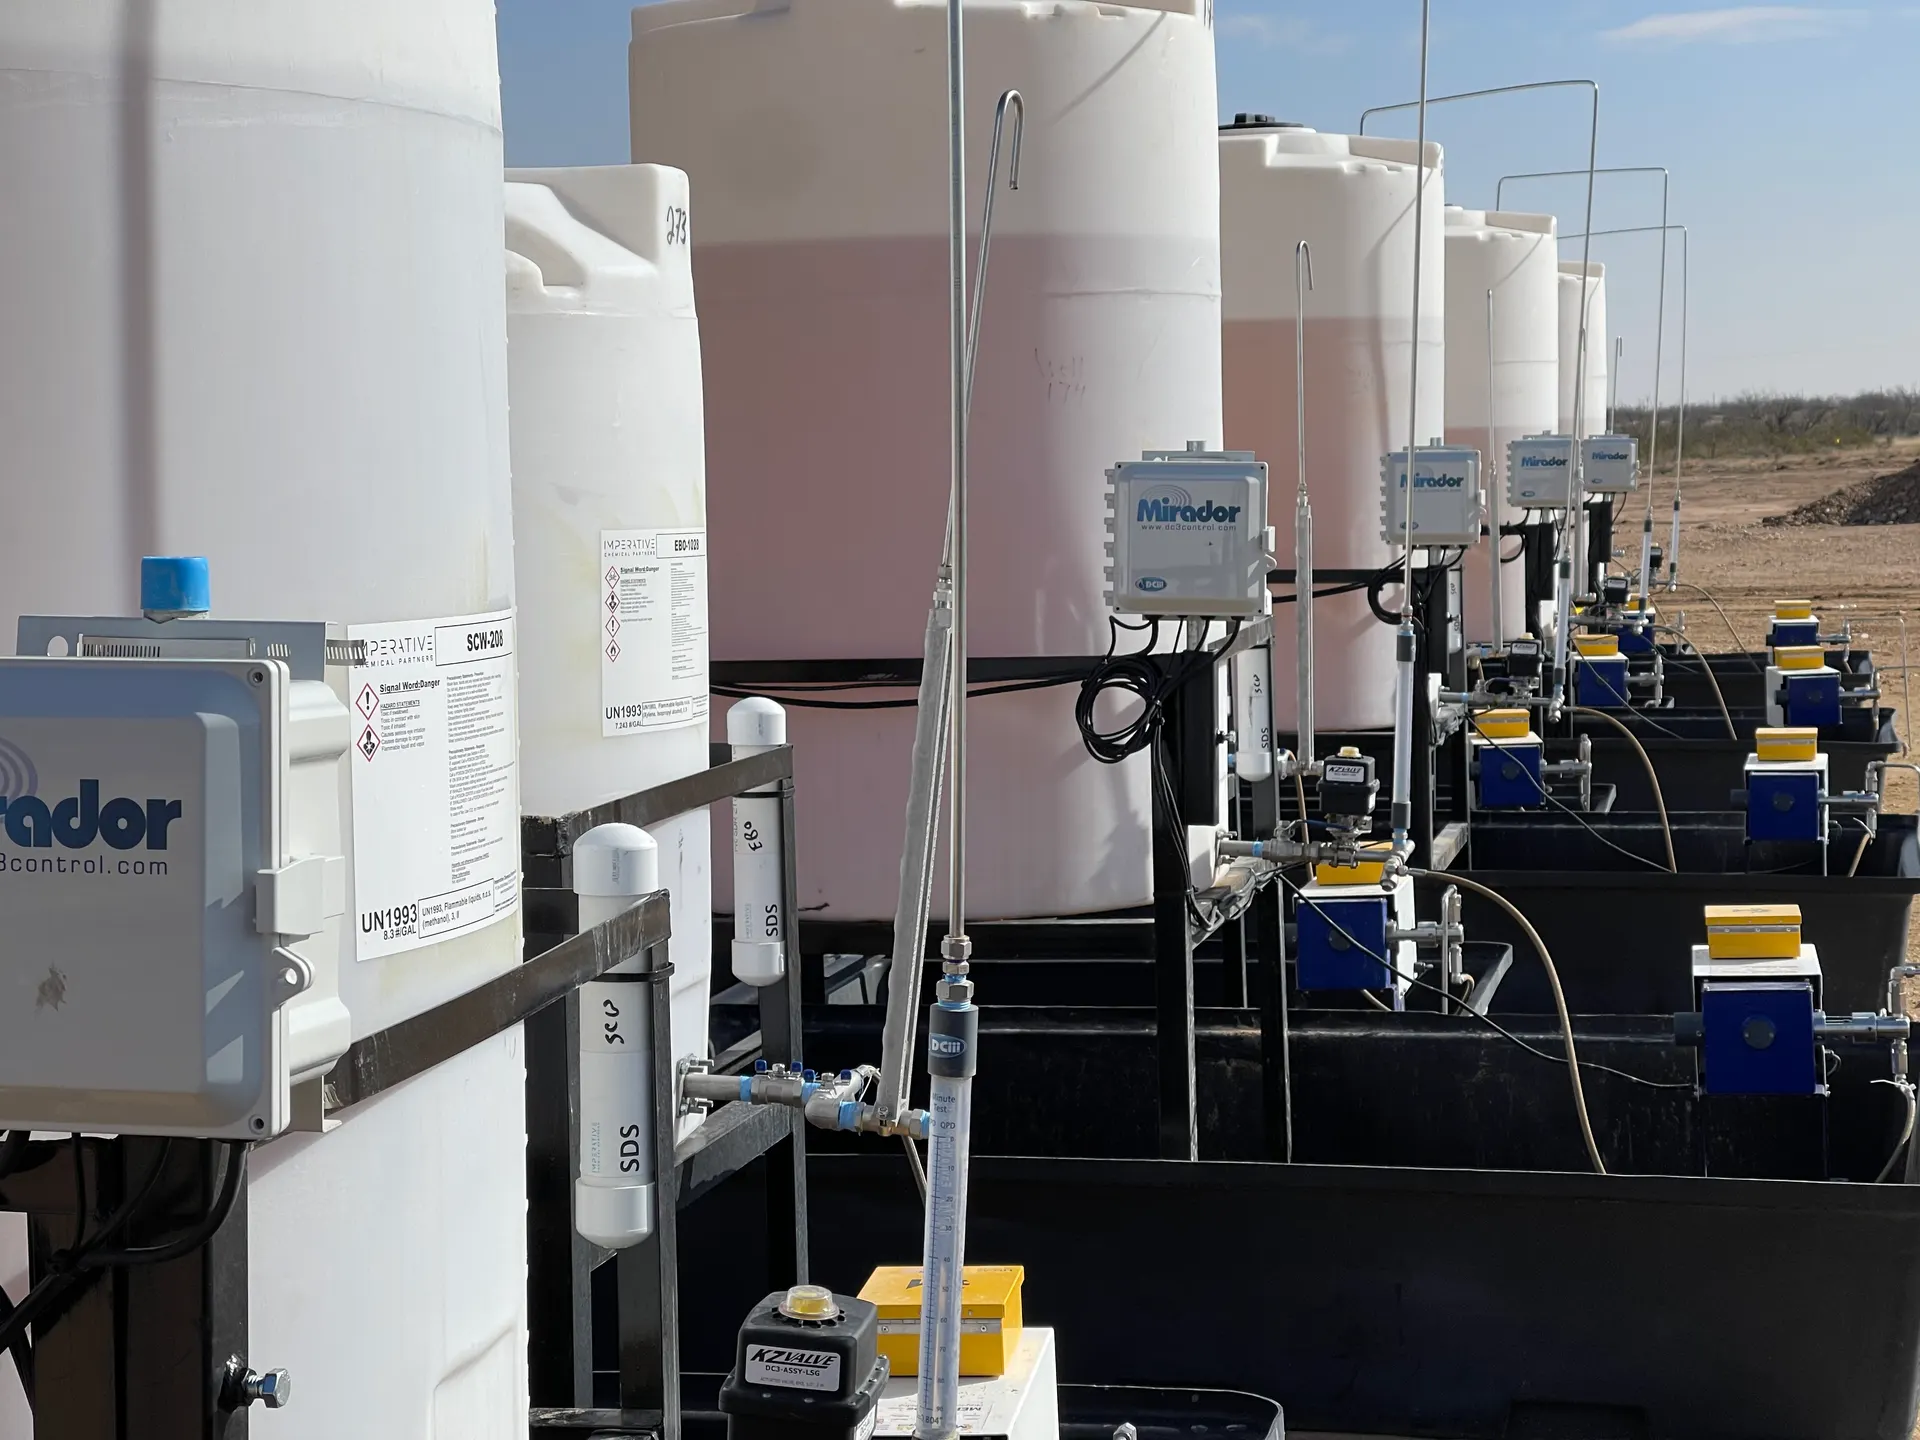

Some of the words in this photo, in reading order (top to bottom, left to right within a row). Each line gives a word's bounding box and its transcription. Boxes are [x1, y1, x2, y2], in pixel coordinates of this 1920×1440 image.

[667, 206, 687, 245] 273
[1521, 456, 1568, 467] Mirador
[1592, 451, 1629, 460] Mirador
[1137, 497, 1241, 523] Mirador
[1141, 523, 1236, 531] www.dc3control.com
[604, 539, 655, 550] IMPERATIVE
[467, 630, 504, 651] SCW-208
[399, 655, 433, 664] PARTNERS
[380, 682, 401, 694] Signal
[606, 705, 641, 719] UN1993
[1261, 727, 1269, 749] SDS
[362, 904, 417, 933] UN1993
[765, 904, 779, 937] SDS
[620, 1124, 640, 1173] SDS
[750, 1349, 837, 1366] KZVALVE
[765, 1365, 820, 1377] DC3-ASSY-LSG
